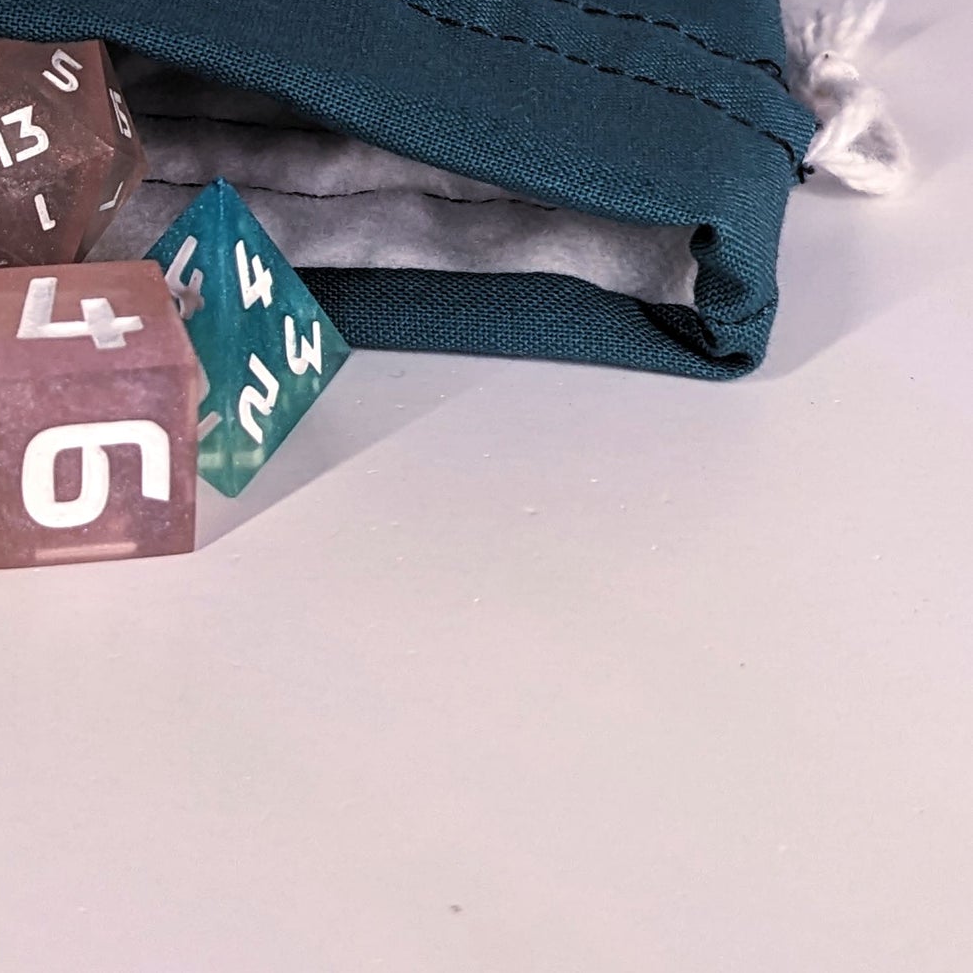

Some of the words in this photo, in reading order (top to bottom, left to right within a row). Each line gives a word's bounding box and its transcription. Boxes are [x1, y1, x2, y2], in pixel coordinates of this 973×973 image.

[41, 48, 83, 93] 5
[33, 193, 57, 231] 1
[235, 239, 274, 310] 4
[17, 277, 144, 349] 4
[284, 315, 323, 376] 3
[238, 352, 280, 444] 2
[21, 419, 171, 529] 6
